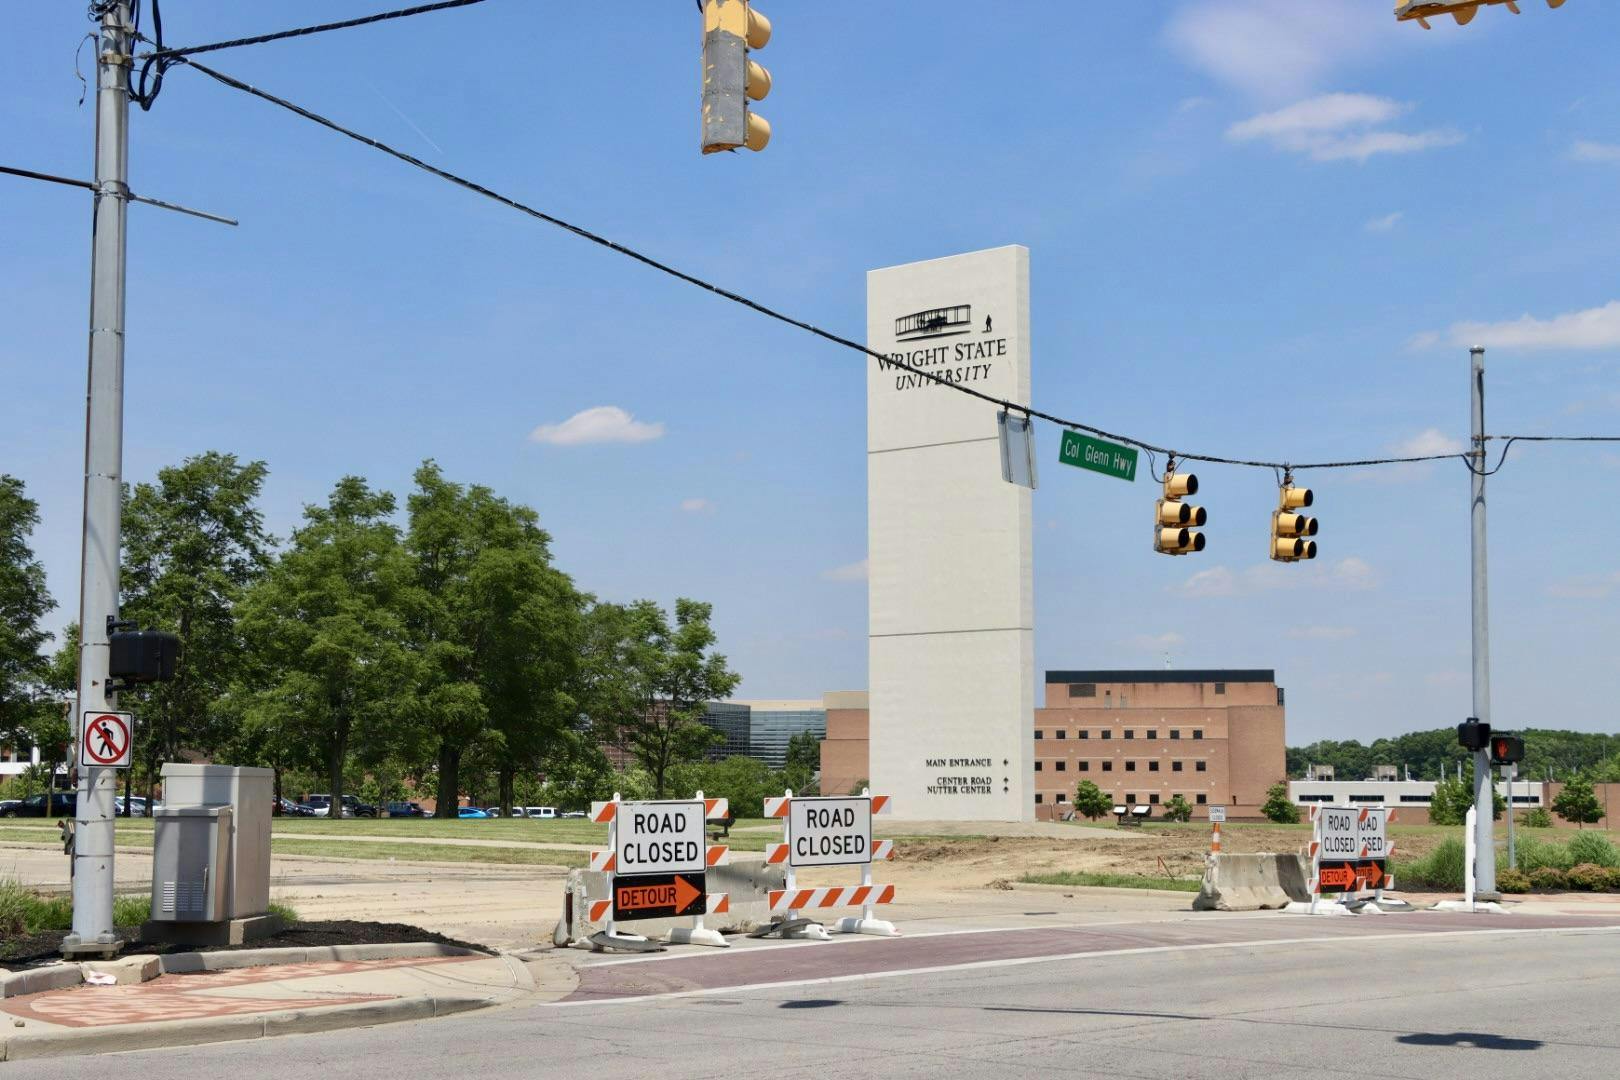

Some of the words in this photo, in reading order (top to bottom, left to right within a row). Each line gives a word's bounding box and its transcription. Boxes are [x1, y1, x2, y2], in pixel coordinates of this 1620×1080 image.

[878, 346, 949, 371] WRIGHT
[955, 339, 1006, 361] STATE
[896, 364, 992, 390] UNIVERSITY
[1065, 439, 1080, 458] Col
[1085, 444, 1109, 467] Glenn
[1113, 452, 1133, 476] Hwy
[926, 759, 946, 767] MAIN
[949, 758, 992, 767] ENTRANCE
[927, 786, 958, 794] NUTTER
[961, 786, 992, 794] CENTER
[937, 777, 968, 785] CENTER
[971, 777, 992, 785] ROAD
[634, 813, 686, 834] ROAD
[807, 808, 855, 829] ROAD
[1329, 816, 1350, 831] ROAD
[1358, 817, 1377, 831] OAD
[624, 841, 698, 864] CLOSED
[797, 835, 865, 857] CLOSED
[1325, 837, 1355, 852] CLOSED
[1322, 870, 1347, 883] DETOUR
[621, 887, 677, 907] DETOUR
